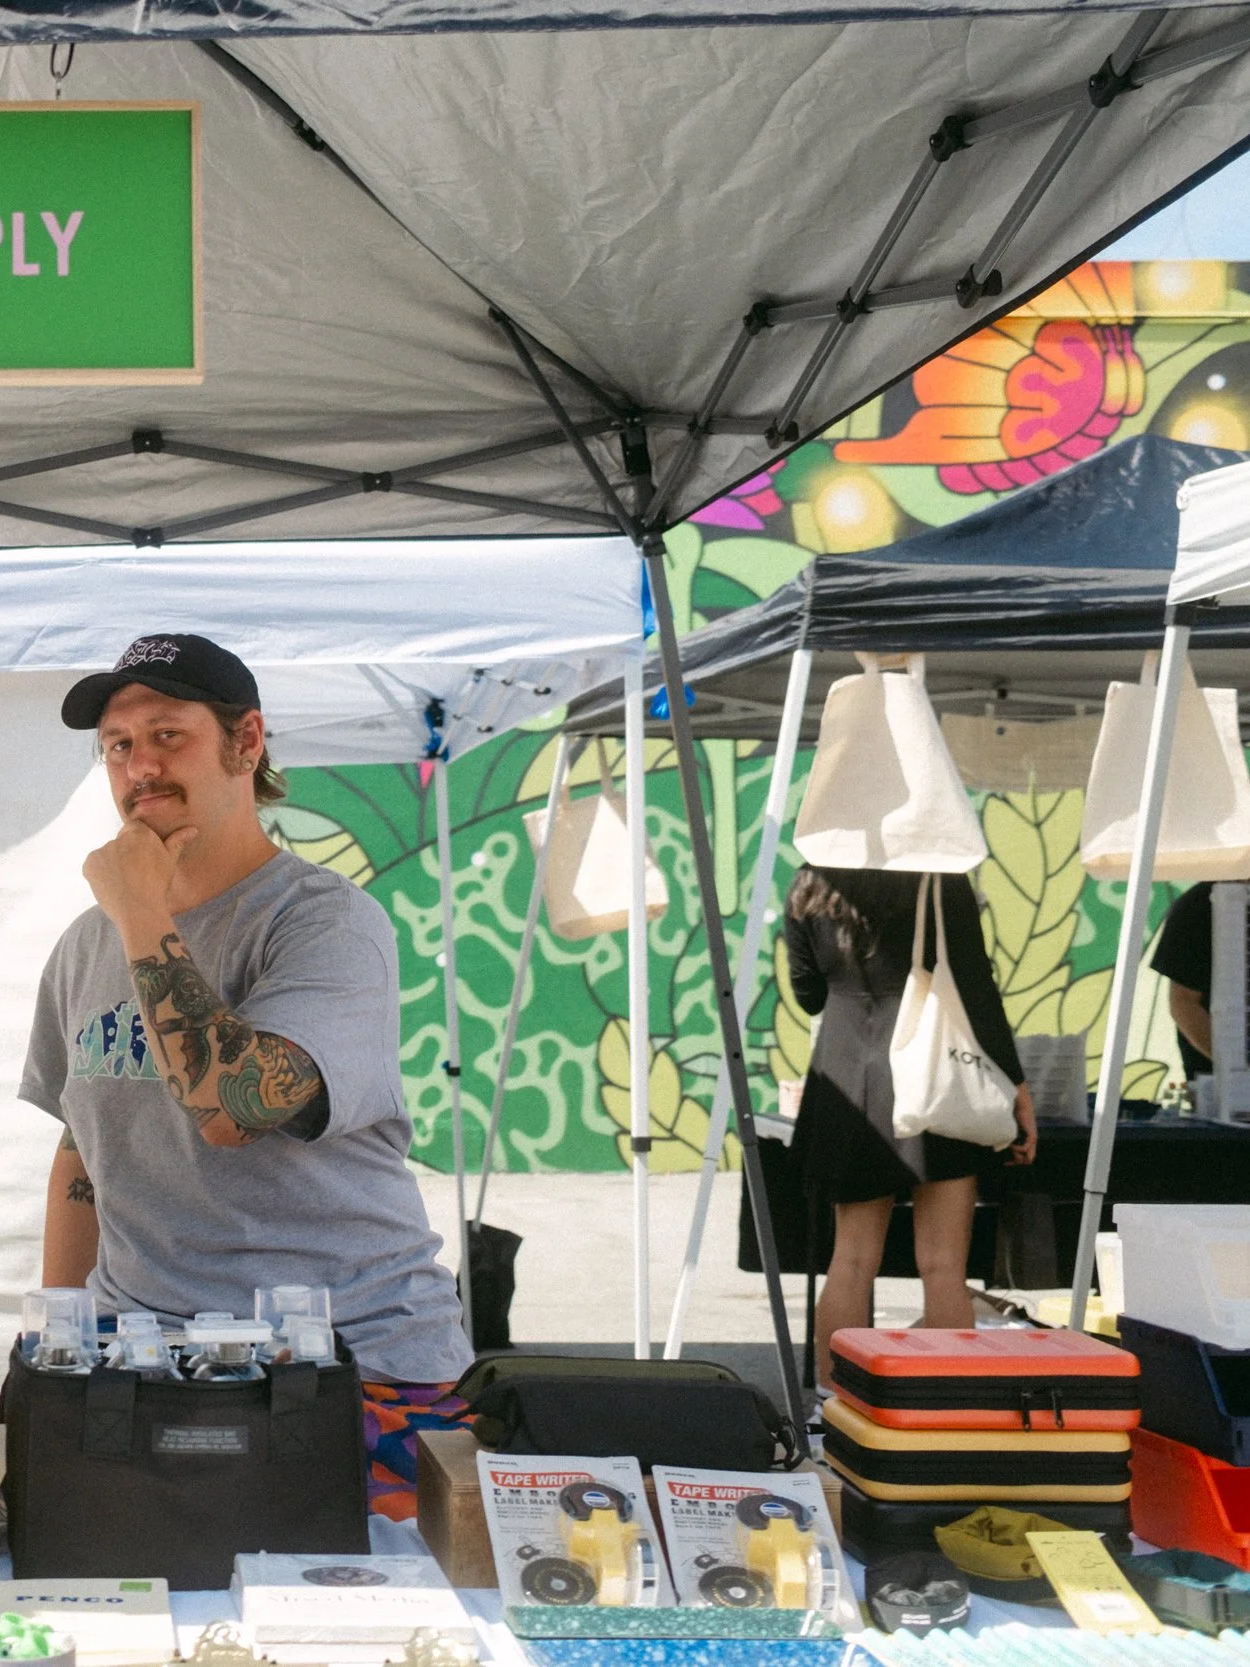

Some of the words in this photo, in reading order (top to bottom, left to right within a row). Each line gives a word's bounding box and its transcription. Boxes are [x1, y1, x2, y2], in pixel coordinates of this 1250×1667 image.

[495, 1473, 532, 1486] TAPE
[672, 1484, 711, 1497] TAPE
[713, 1487, 762, 1499] WRIT
[530, 1499, 560, 1507] MAK
[707, 1509, 736, 1518] MAK
[15, 1595, 124, 1604] PENCO
